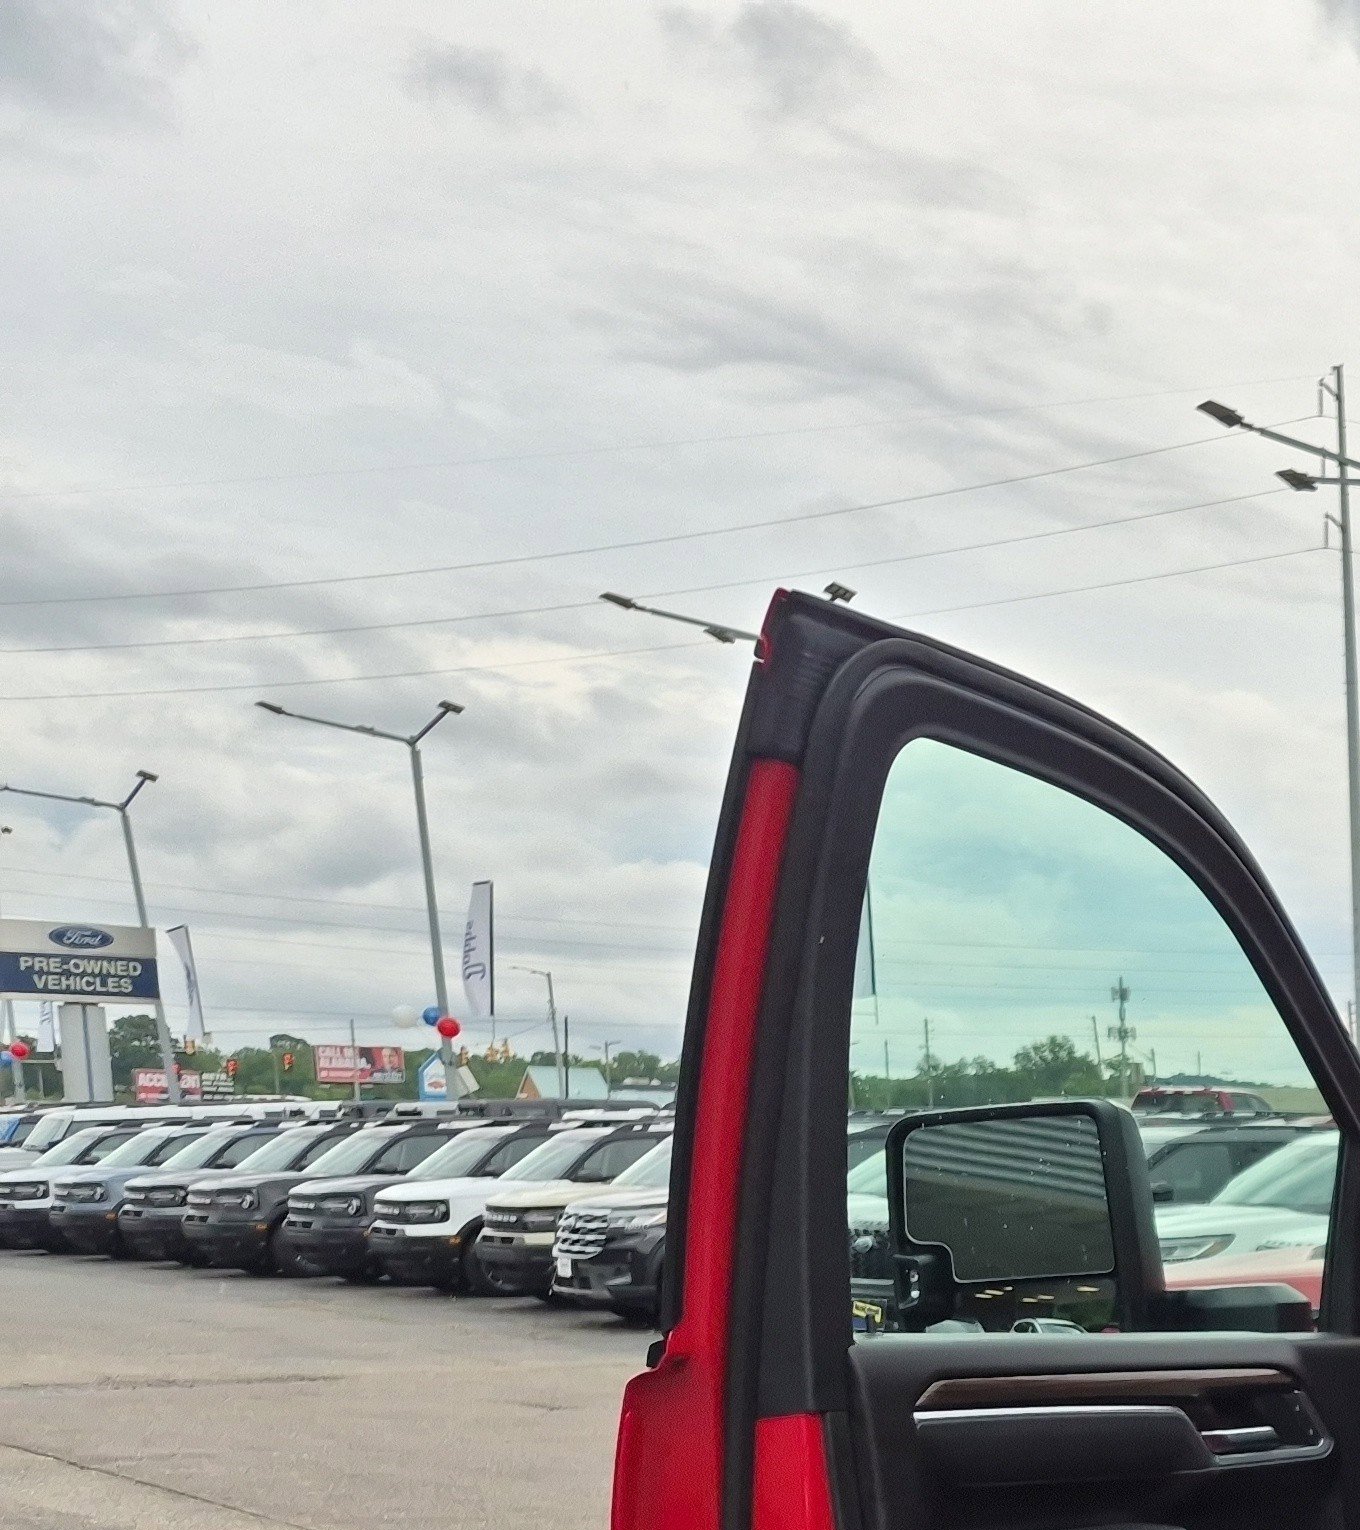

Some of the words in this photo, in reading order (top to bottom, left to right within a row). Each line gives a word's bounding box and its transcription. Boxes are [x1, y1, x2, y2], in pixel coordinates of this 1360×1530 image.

[62, 930, 102, 944] Ford
[19, 957, 141, 976] PRE-OWNED
[33, 974, 132, 993] VEHICLES
